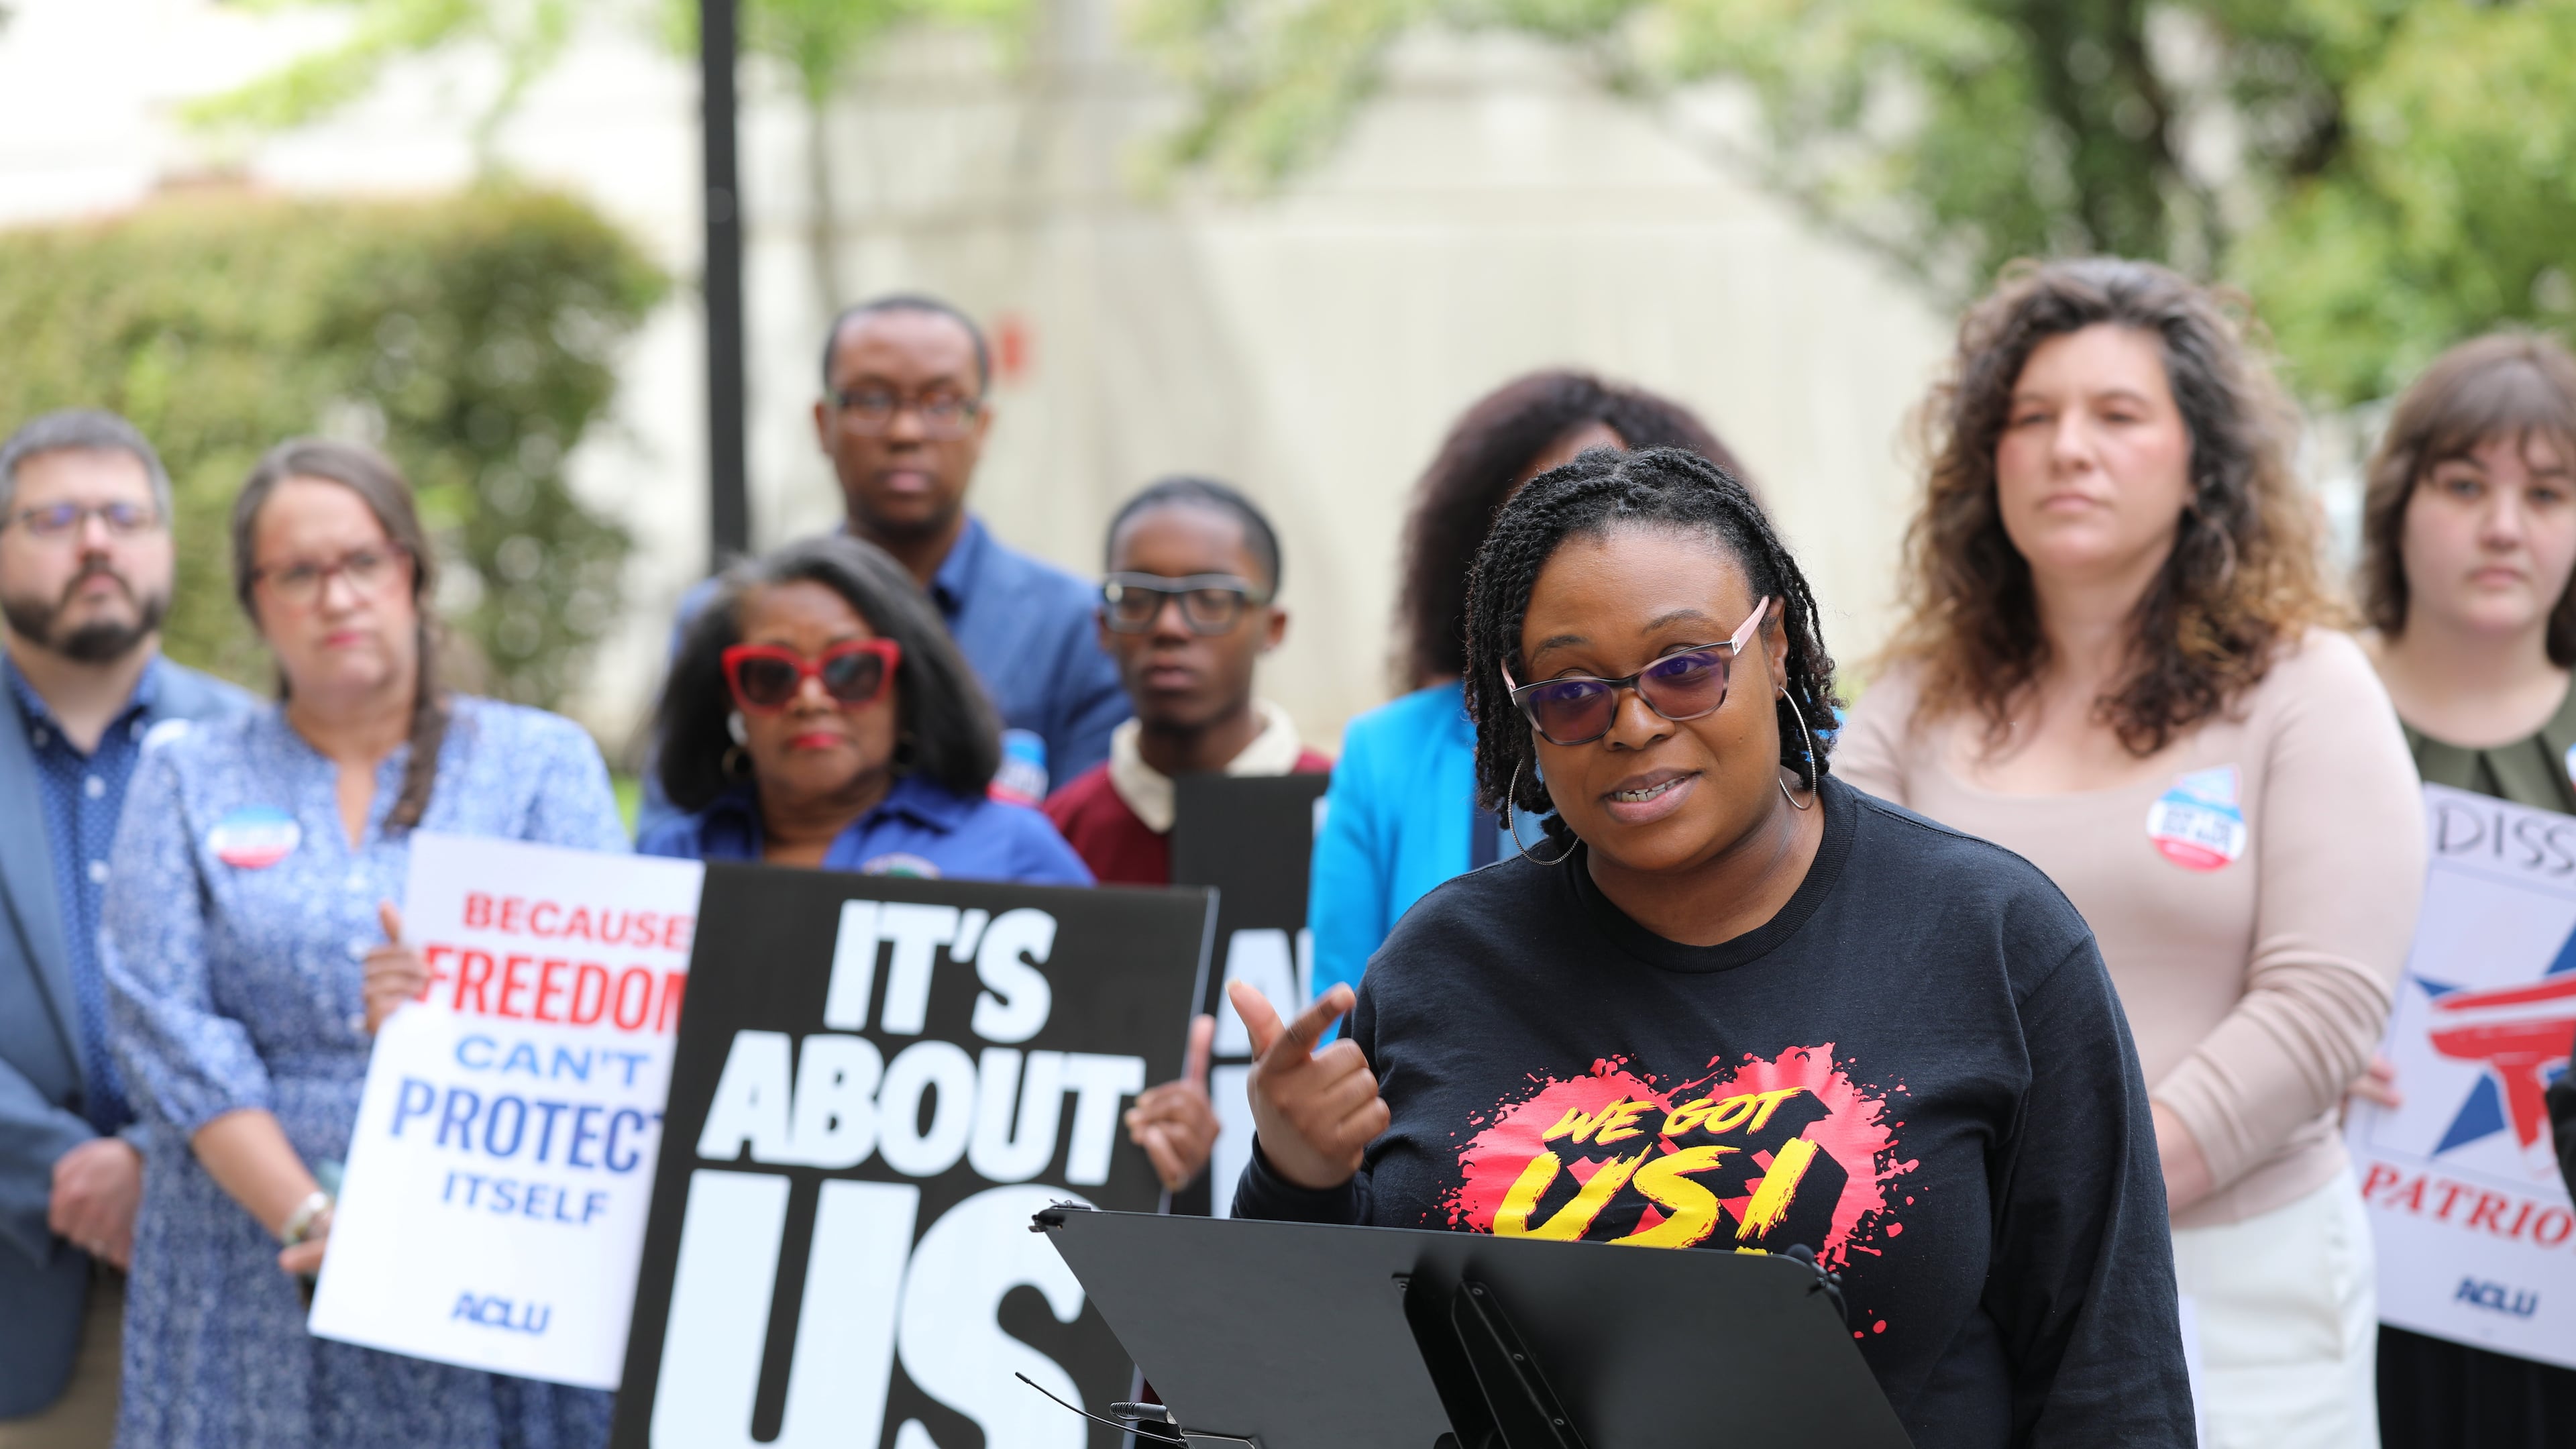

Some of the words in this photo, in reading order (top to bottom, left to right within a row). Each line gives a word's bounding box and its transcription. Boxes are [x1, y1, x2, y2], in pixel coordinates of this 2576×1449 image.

[2437, 798, 2576, 876] DISS
[463, 892, 692, 953] BECAUSE
[824, 899, 1057, 1043] IT'S
[453, 1034, 652, 1087] CAN'T
[389, 1079, 665, 1174] PROTEC
[696, 1030, 1146, 1186] ABOUT
[1542, 1097, 1658, 1144] WE
[1662, 1086, 1809, 1136] GOT
[443, 1169, 609, 1226] ITSELF
[1493, 1136, 1819, 1256] US!
[2362, 1164, 2576, 1250] PATRIO
[451, 1292, 550, 1336] ACLU
[649, 1169, 1100, 1449] US
[2455, 1277, 2538, 1318] ACLU
